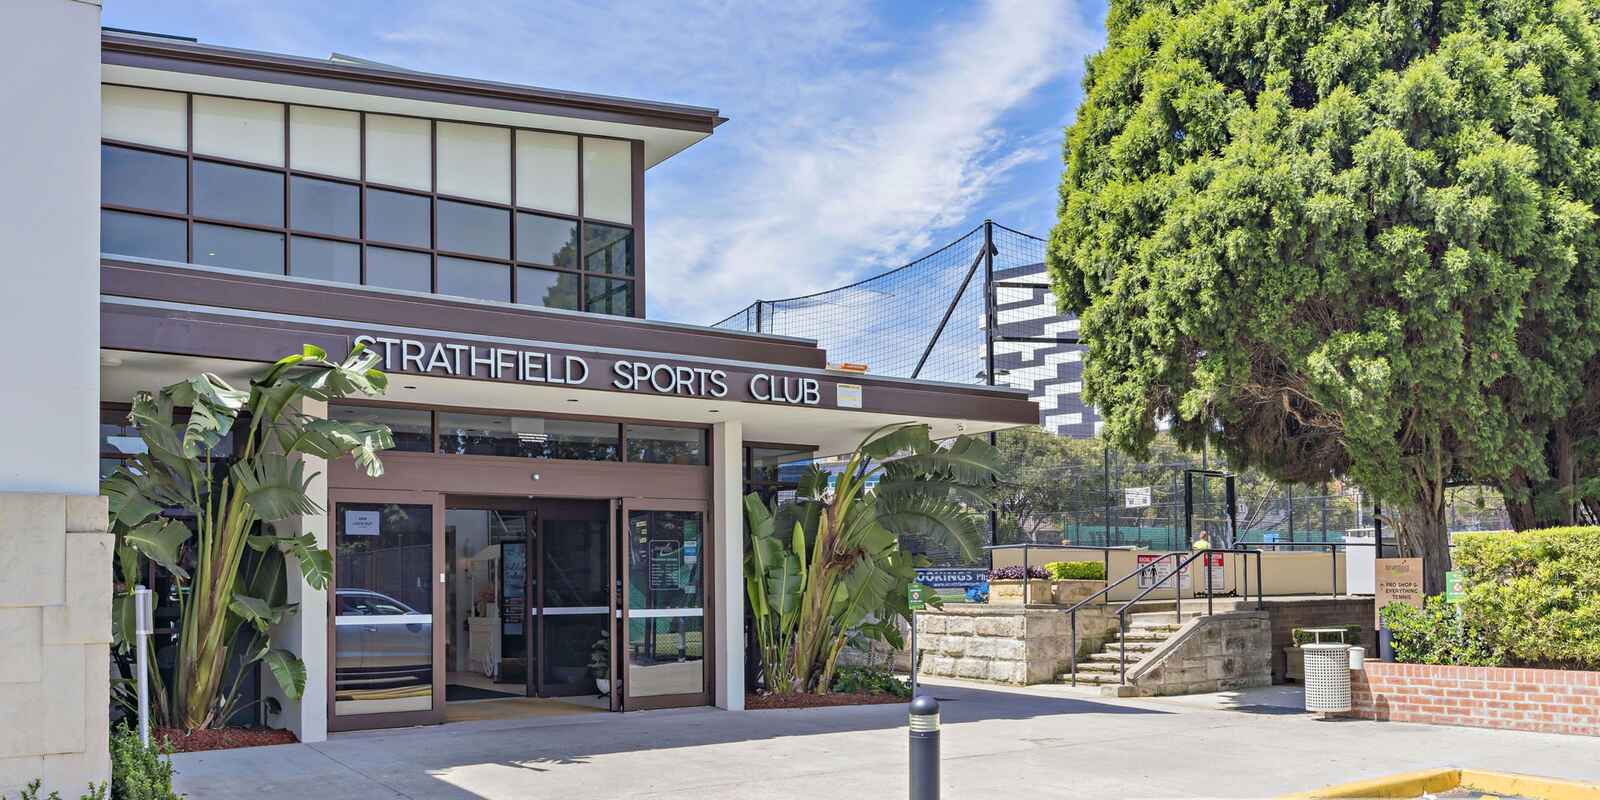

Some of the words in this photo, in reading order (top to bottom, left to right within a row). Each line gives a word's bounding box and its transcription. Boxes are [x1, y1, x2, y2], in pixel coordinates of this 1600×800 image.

[613, 360, 728, 397] SPORTS
[750, 373, 820, 405] CLUB
[915, 571, 972, 581] OOKINGS
